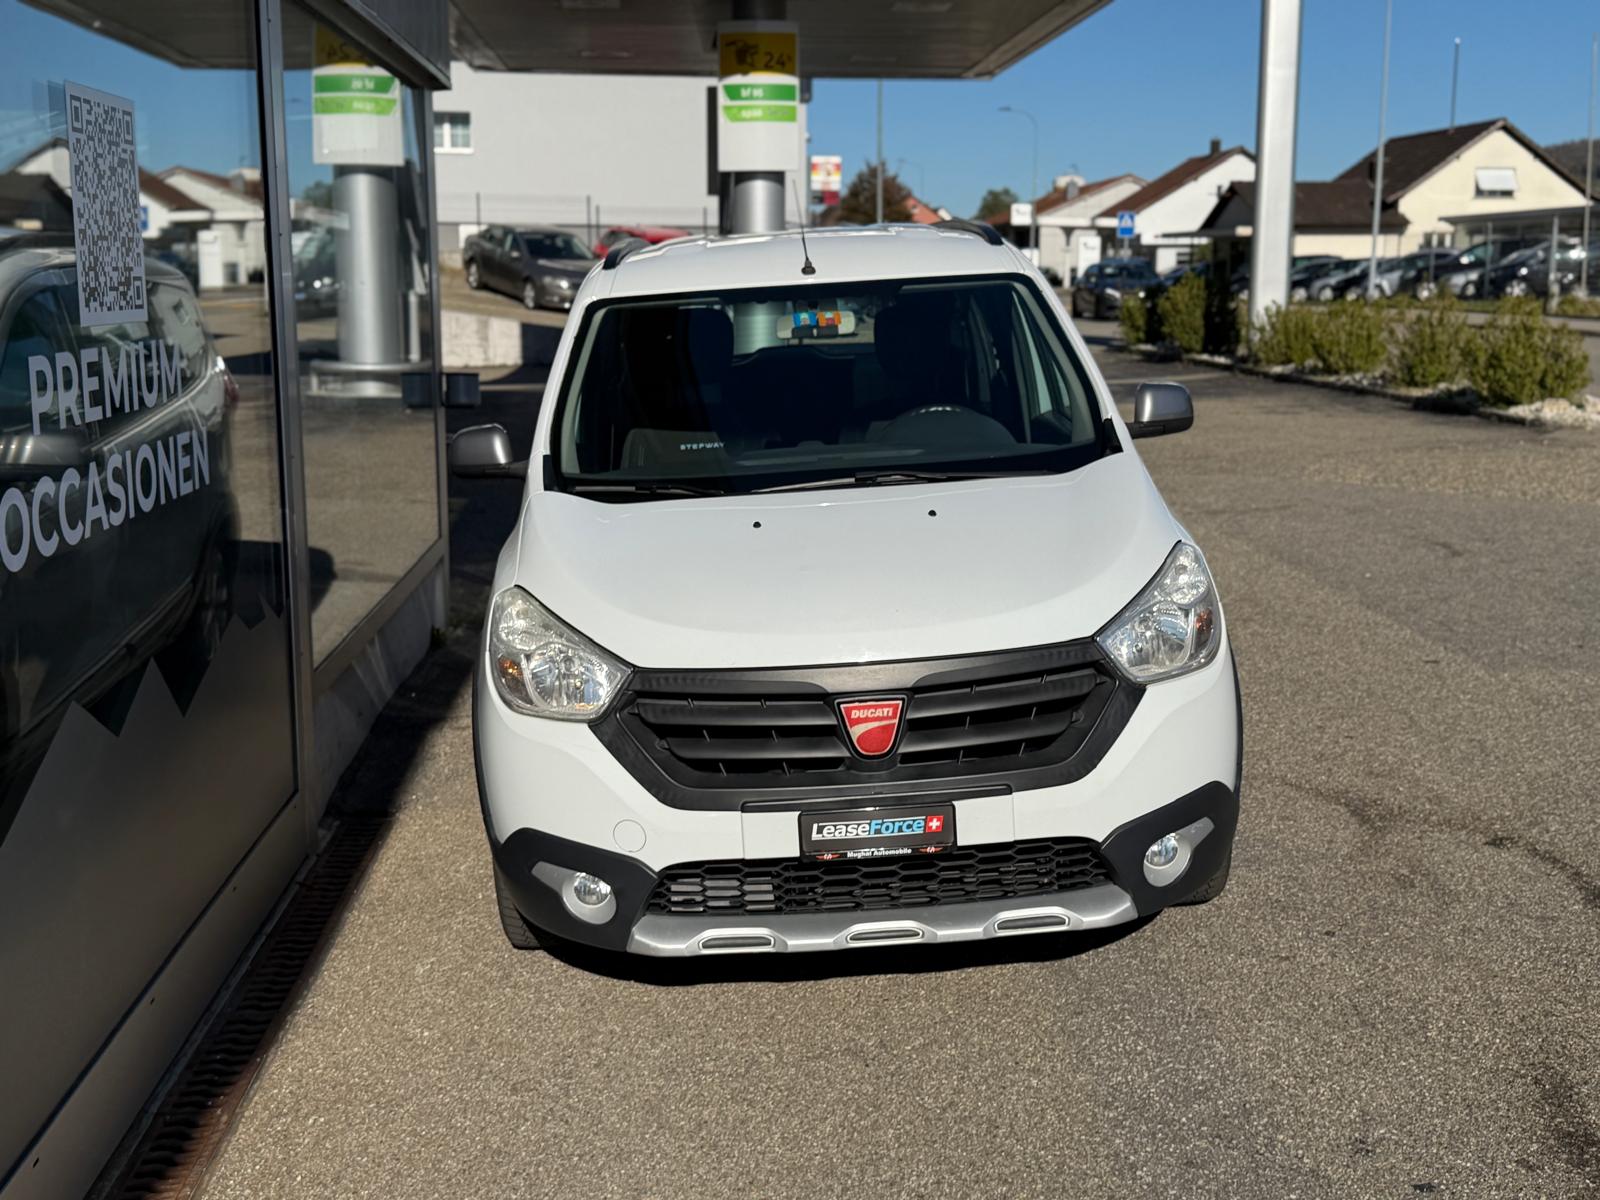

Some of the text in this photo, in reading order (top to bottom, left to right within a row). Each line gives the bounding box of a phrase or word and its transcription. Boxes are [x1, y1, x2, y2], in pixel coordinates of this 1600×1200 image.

[28, 337, 183, 436] PREMIUM
[680, 442, 725, 450] STEPWAY
[0, 427, 210, 573] OCCASIONEN
[850, 707, 894, 719] DUCATI
[811, 819, 925, 841] LeaseForce
[847, 848, 912, 860] Mughal Automobile
